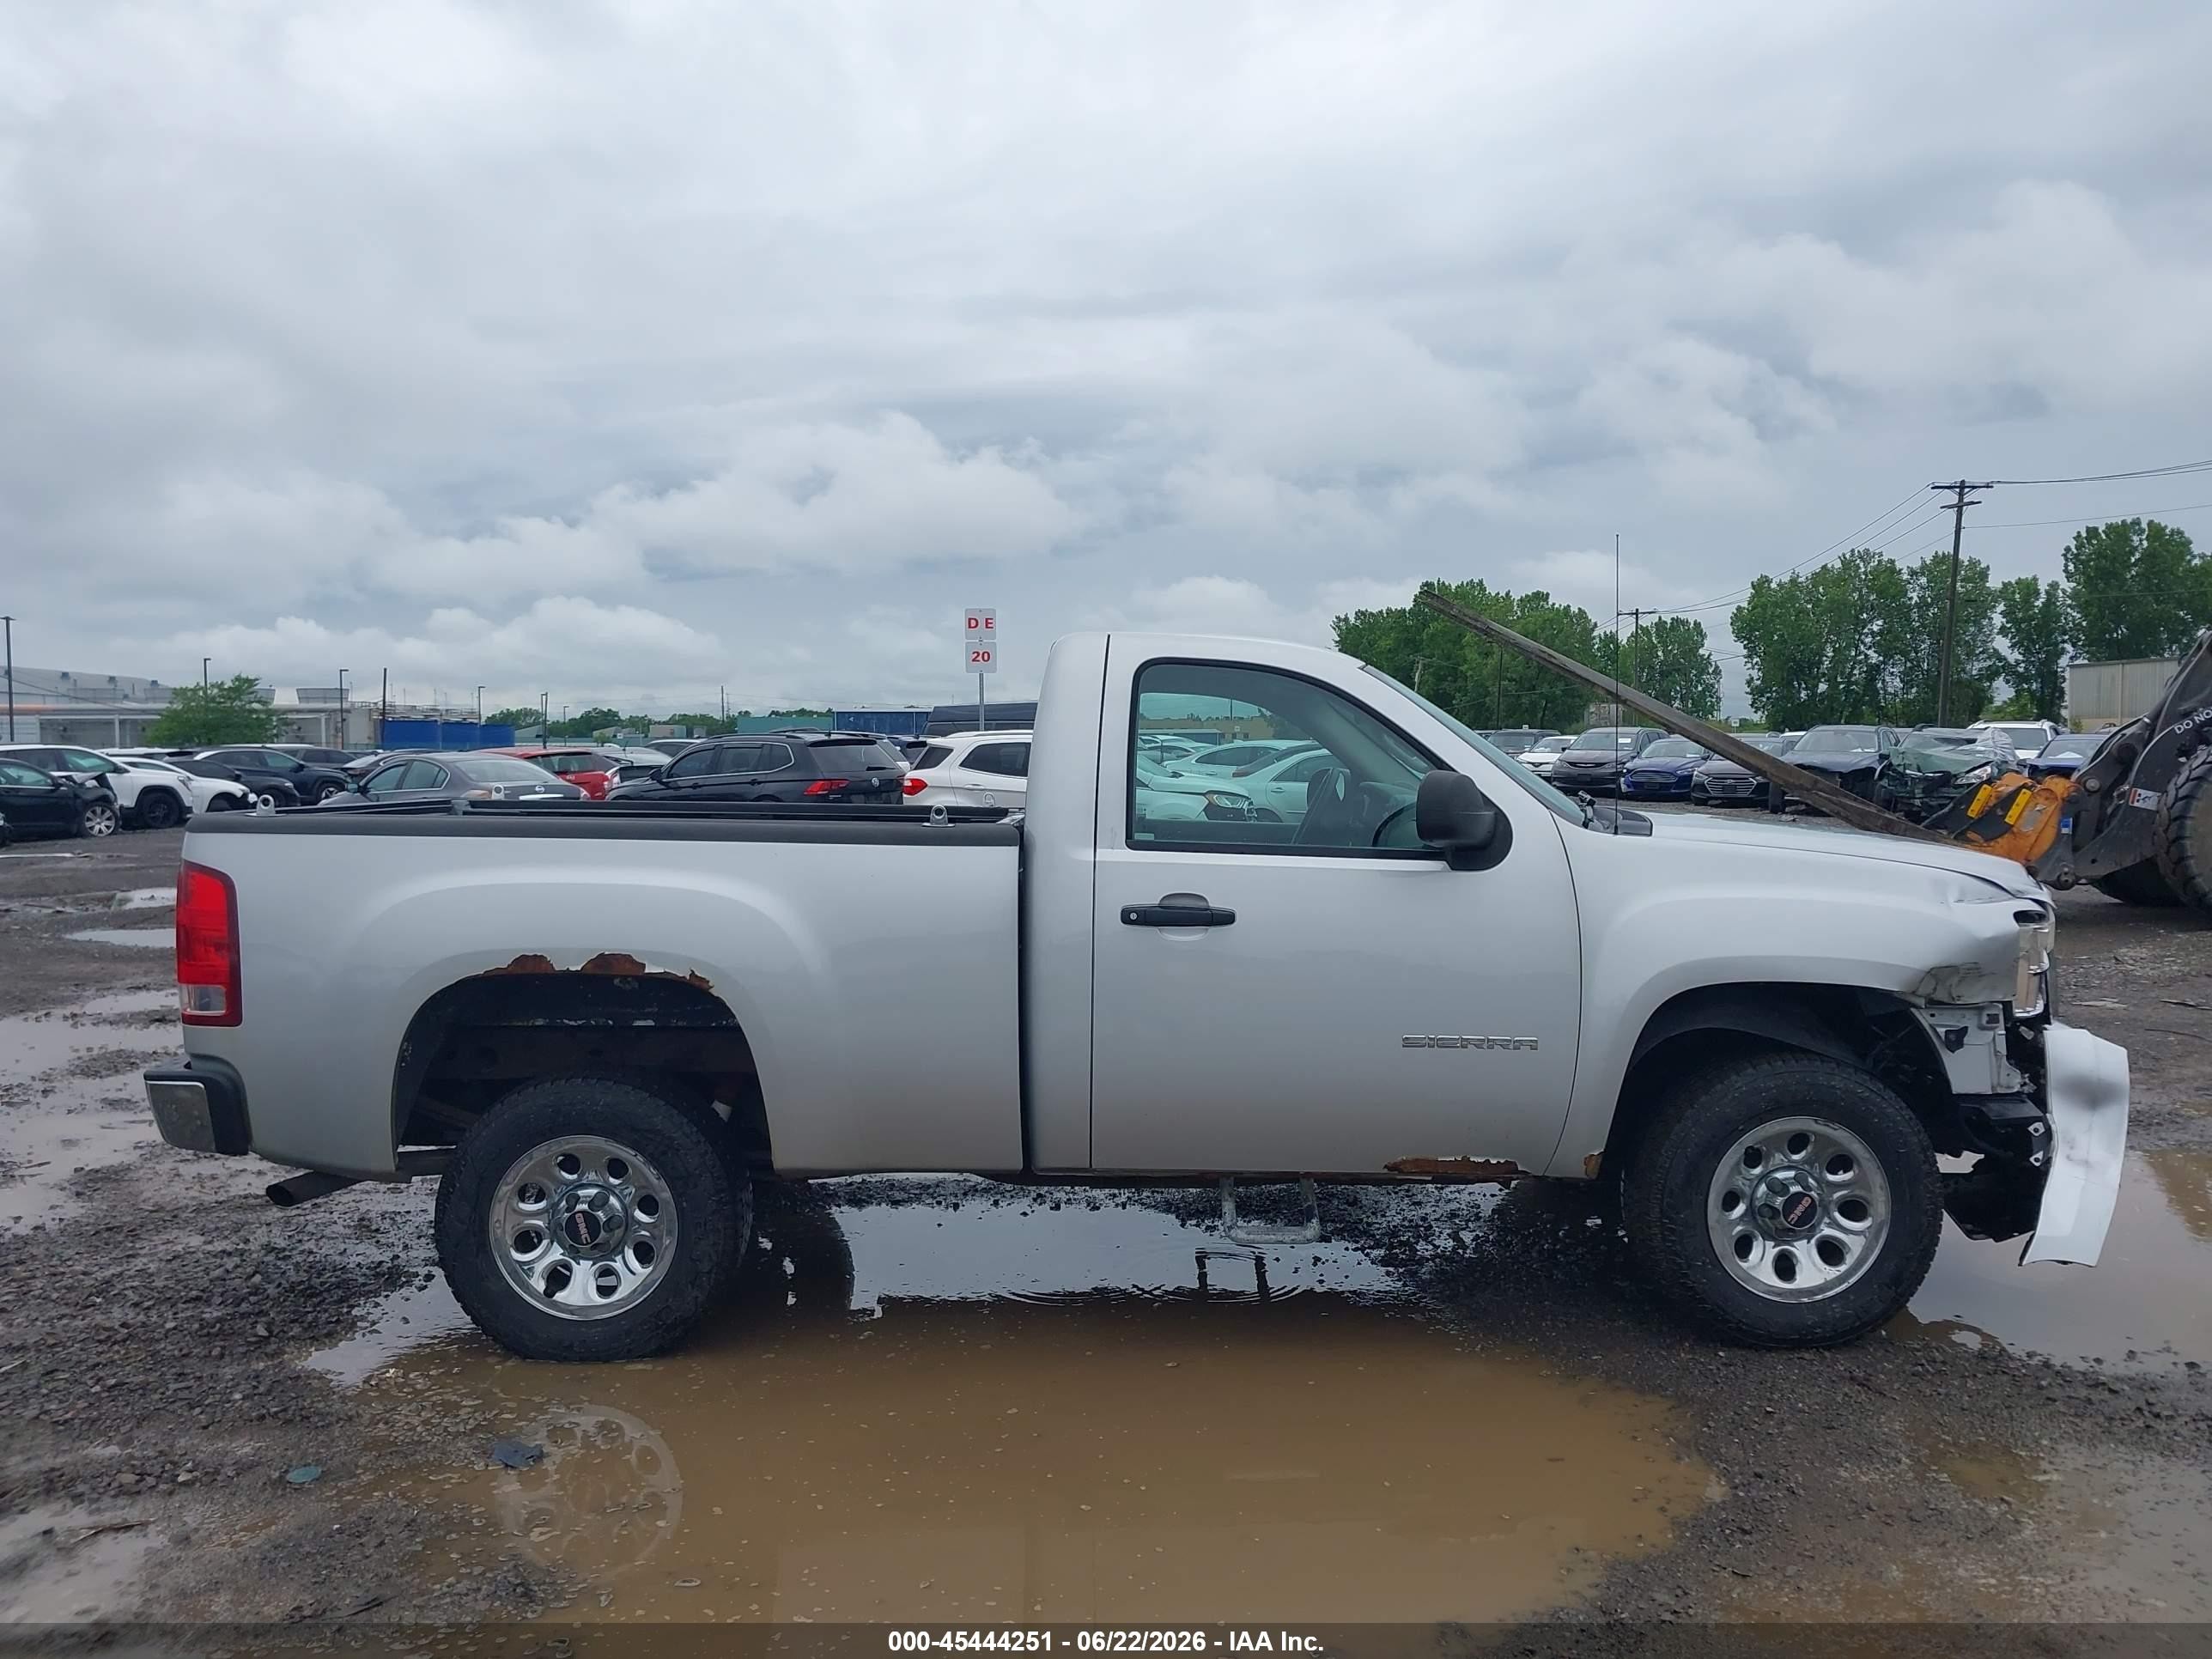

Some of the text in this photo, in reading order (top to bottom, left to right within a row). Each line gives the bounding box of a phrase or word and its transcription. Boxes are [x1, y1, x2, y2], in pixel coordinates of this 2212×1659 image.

[968, 617, 994, 629] D E
[971, 651, 990, 662] 20
[2174, 707, 2212, 733] DO NO
[1402, 1035, 1538, 1050] SIERRA
[1788, 1196, 1812, 1224] GMC
[575, 1212, 591, 1244] GMC
